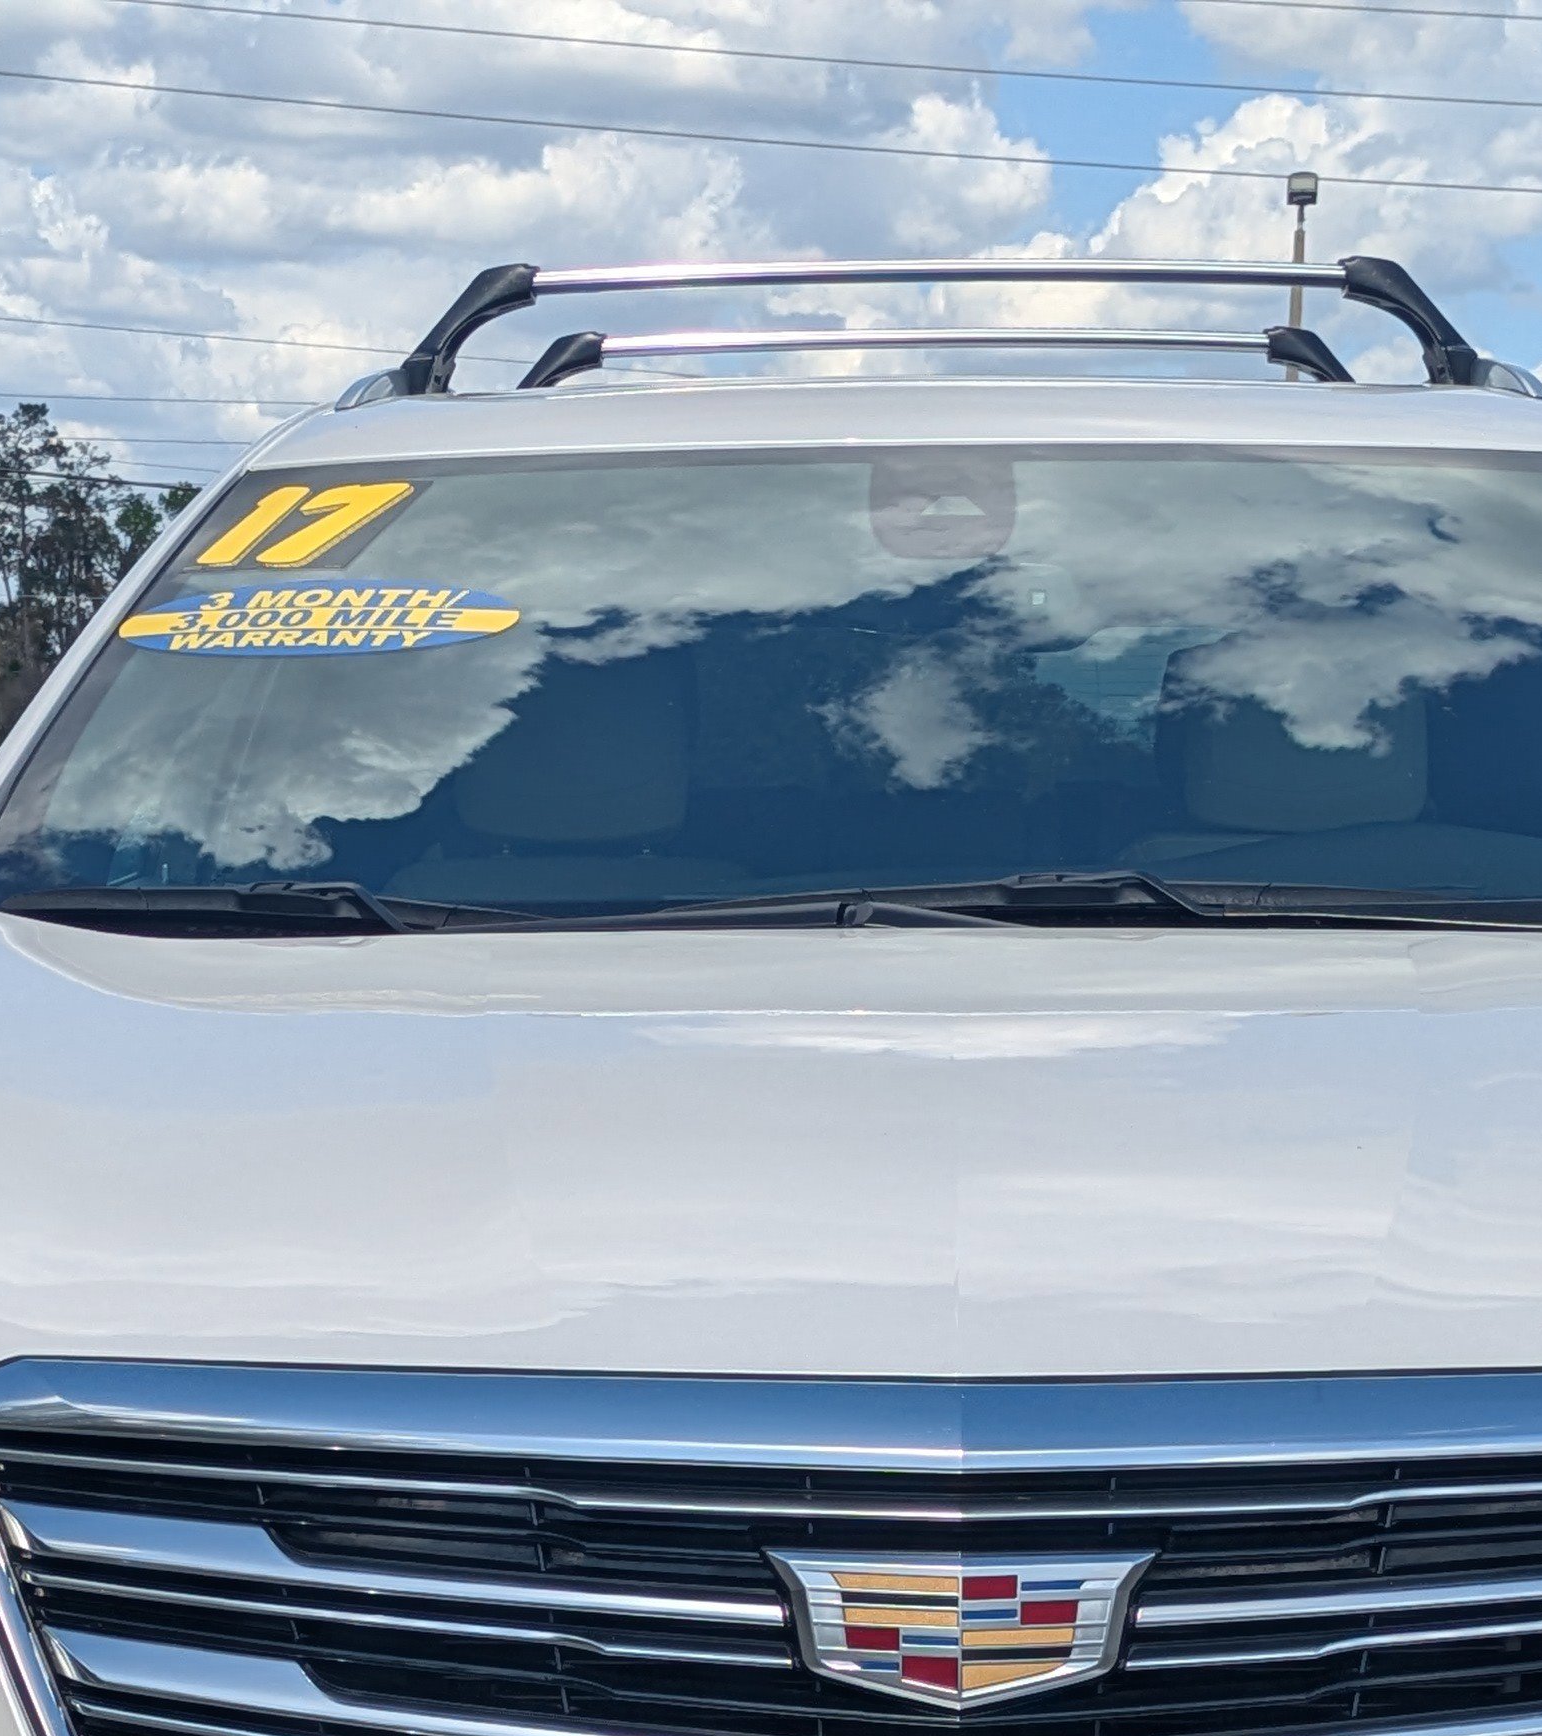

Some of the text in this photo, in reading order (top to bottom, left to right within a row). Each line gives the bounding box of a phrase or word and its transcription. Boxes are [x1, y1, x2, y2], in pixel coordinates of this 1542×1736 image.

[196, 481, 415, 568] 17
[199, 588, 471, 611] 3 MONTH/
[170, 609, 464, 632] 3,000 MILE
[168, 629, 433, 651] WARRANTY
